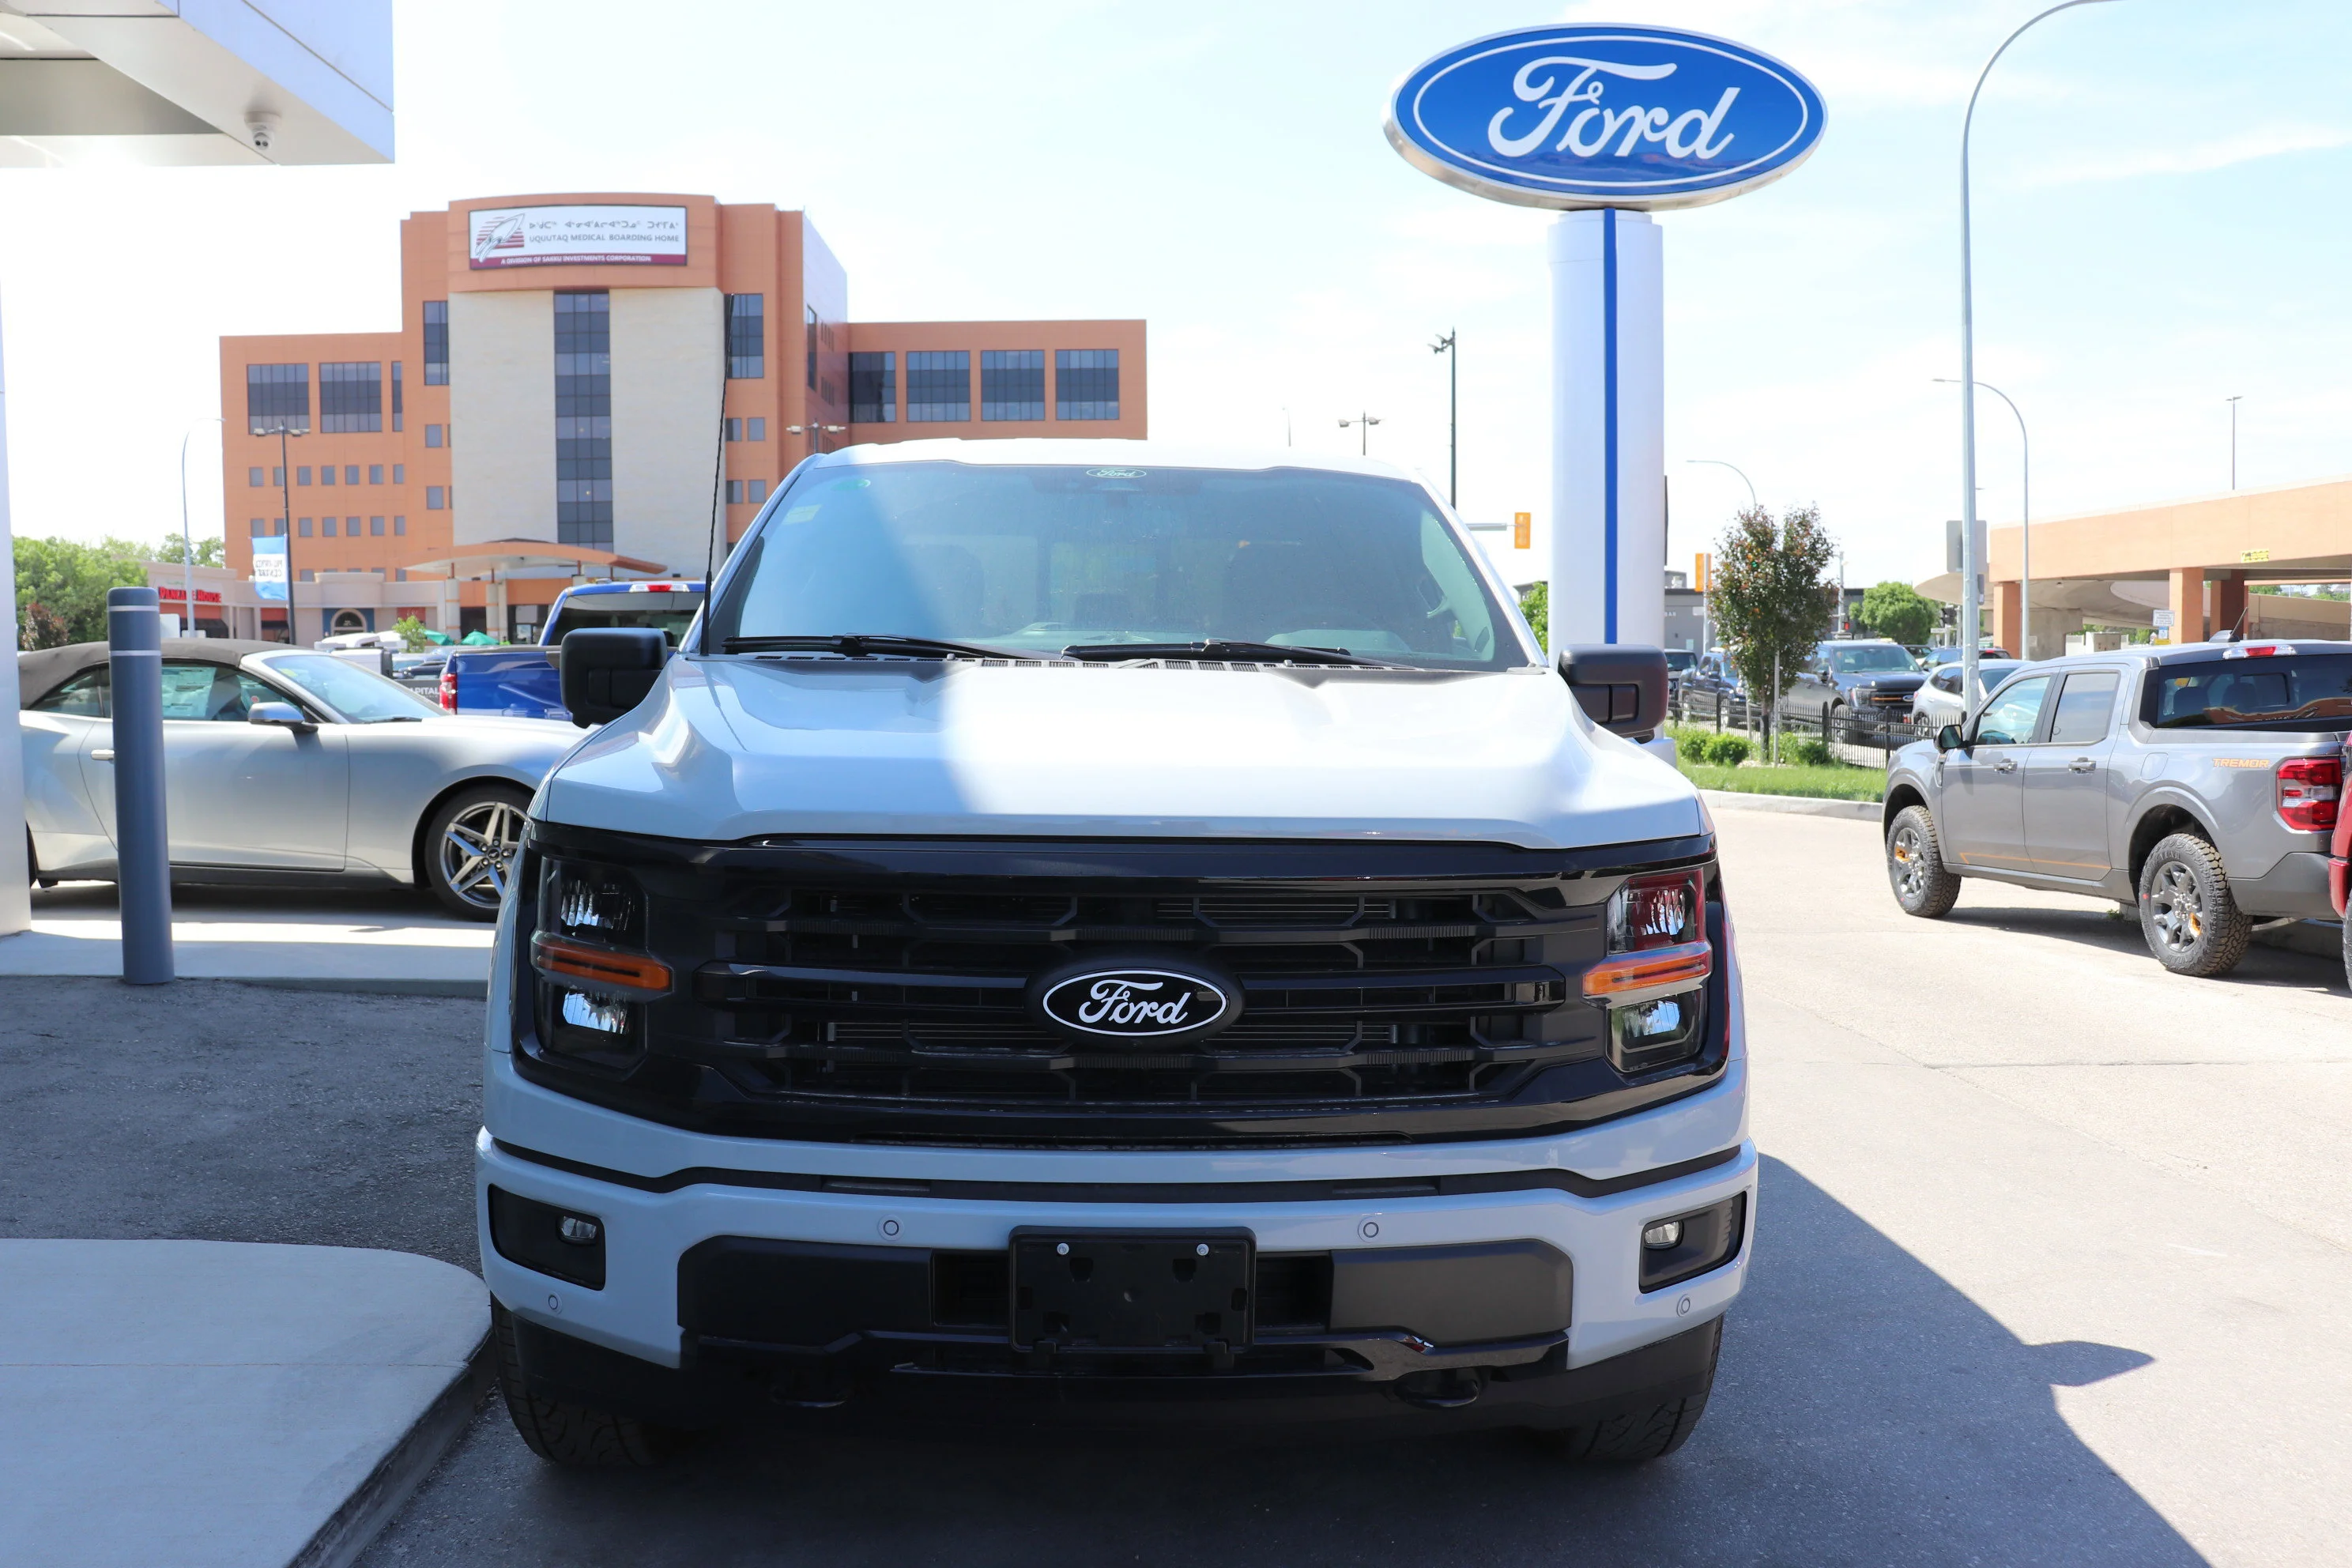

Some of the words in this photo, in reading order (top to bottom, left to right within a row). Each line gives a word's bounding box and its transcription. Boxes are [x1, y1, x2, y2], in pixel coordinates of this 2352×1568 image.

[1487, 56, 1741, 159] Ford
[1097, 468, 1136, 477] Ford
[196, 589, 222, 603] HOUSE
[2212, 758, 2271, 769] TREMOR
[1078, 979, 1191, 1024] Ford
